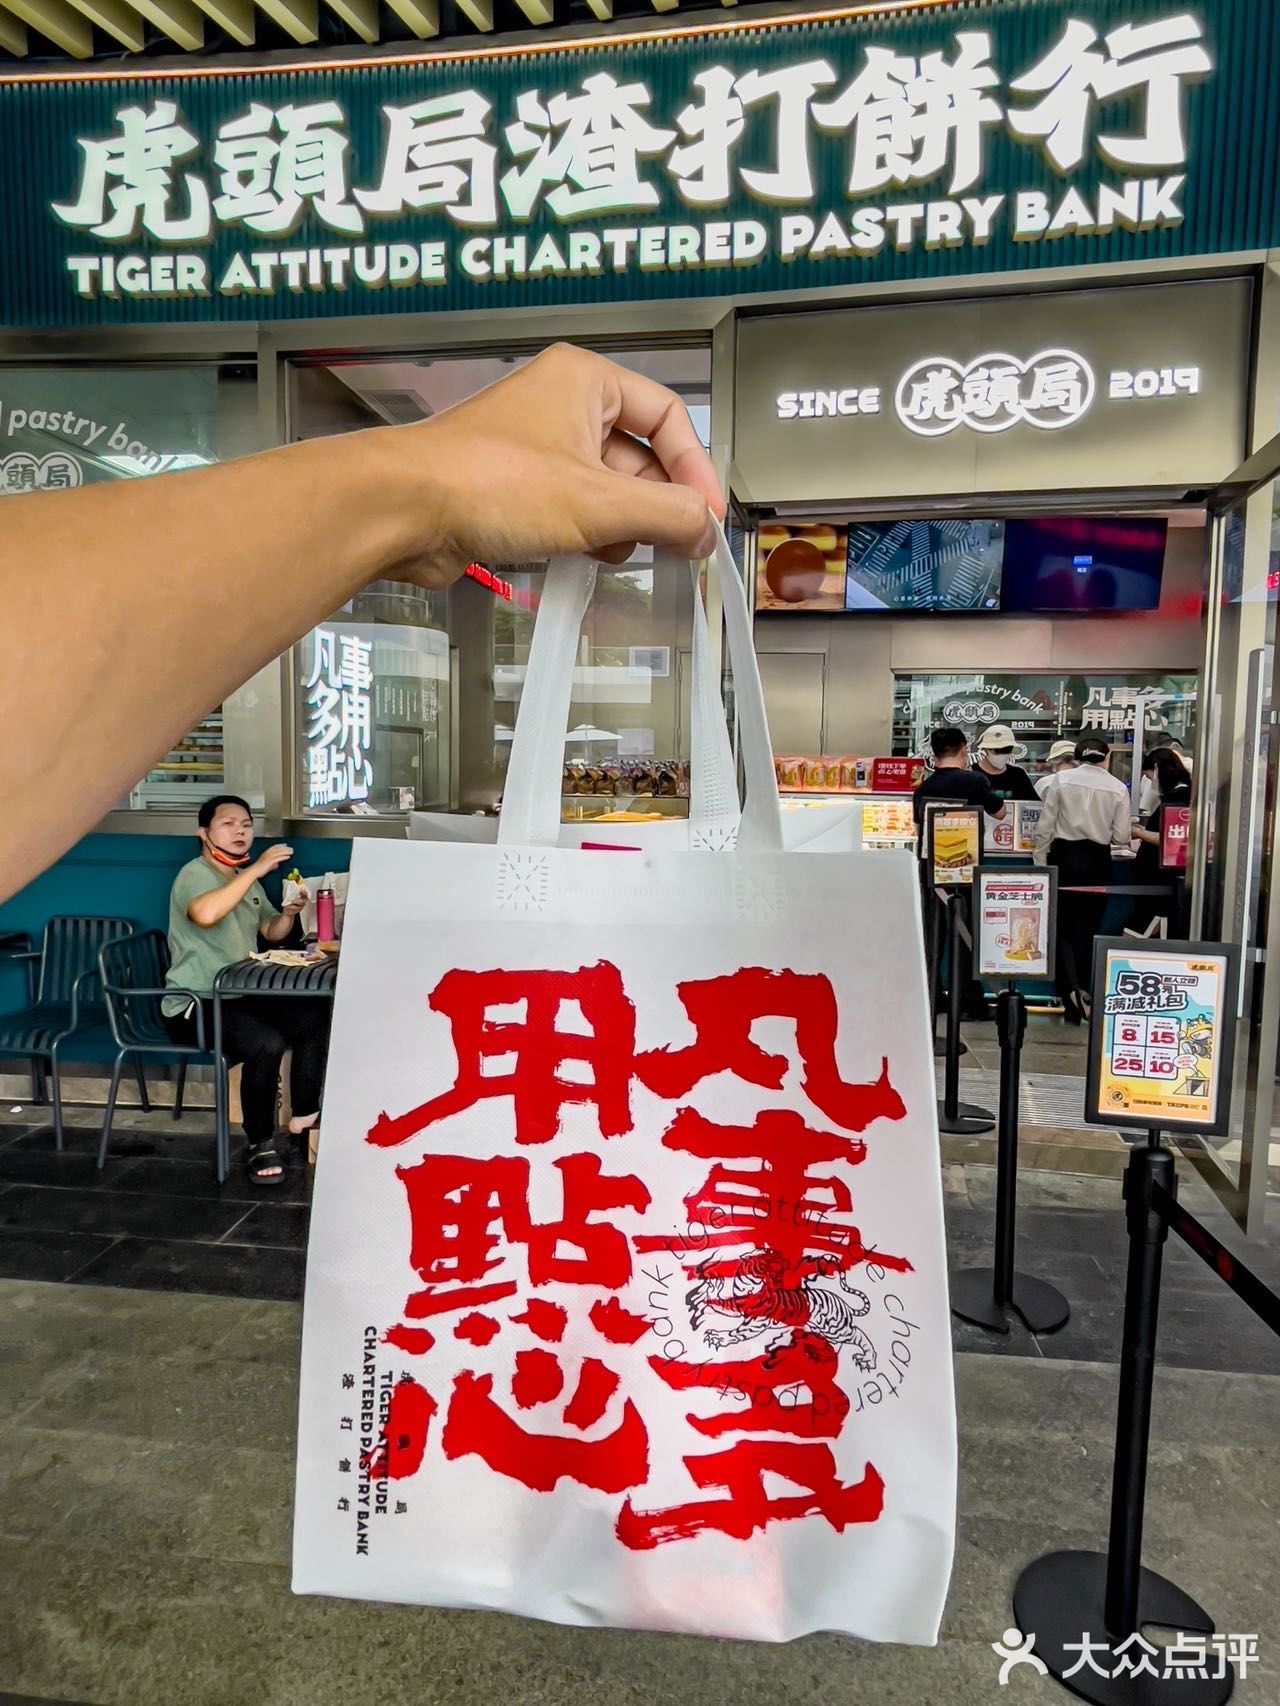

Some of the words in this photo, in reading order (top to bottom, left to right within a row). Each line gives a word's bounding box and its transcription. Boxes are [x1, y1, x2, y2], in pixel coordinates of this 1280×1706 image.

[51, 14, 1213, 243] 虎頭局渣打餅行
[66, 255, 207, 298] TIGER
[219, 241, 447, 294] ATTITUDE
[460, 220, 767, 285] CHARTERED
[780, 193, 1004, 261] PASTRY
[1014, 174, 1186, 243] BANK
[903, 361, 1084, 424] 虎頭局
[1108, 366, 1200, 399] 2019
[776, 387, 881, 420] SINCE
[8, 407, 108, 447] pastry
[1010, 688, 1044, 716] bank
[1167, 824, 1190, 839] 出
[1107, 994, 1184, 1011] 满减礼包
[1121, 1029, 1137, 1041] 8
[1150, 1031, 1175, 1044] 15
[1114, 1058, 1143, 1071] 25
[1149, 1061, 1174, 1074] 10
[360, 1325, 378, 1434] CHARTERED
[377, 1370, 393, 1426] TIGER
[356, 1436, 373, 1507] PASTRY
[355, 1510, 370, 1557] BANK
